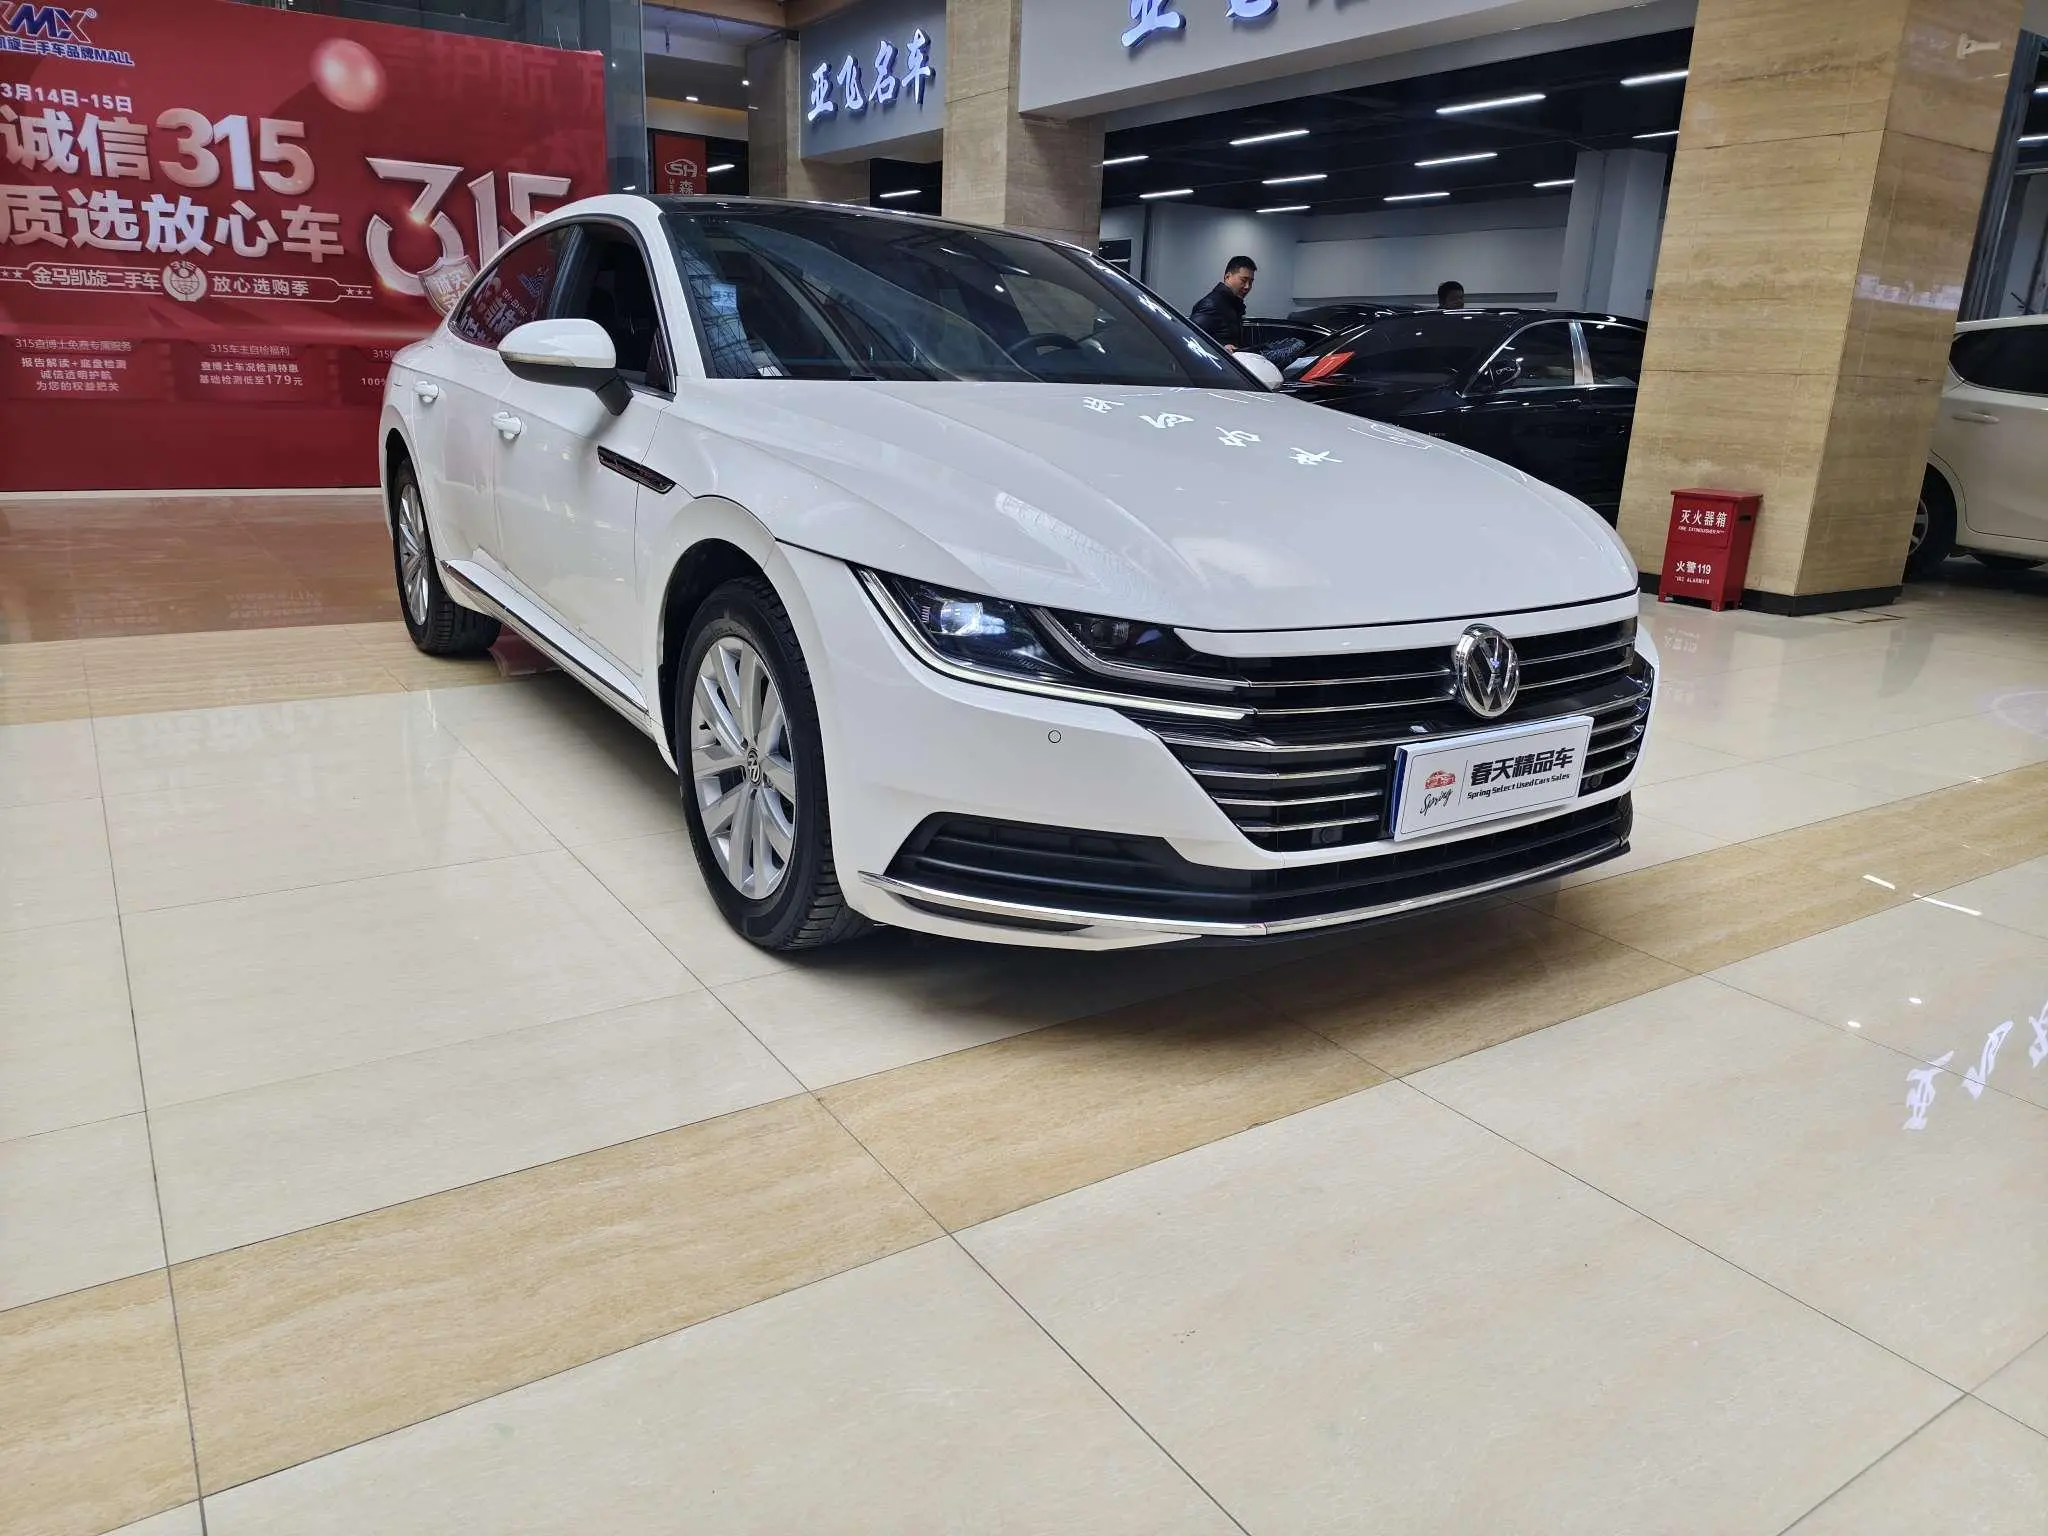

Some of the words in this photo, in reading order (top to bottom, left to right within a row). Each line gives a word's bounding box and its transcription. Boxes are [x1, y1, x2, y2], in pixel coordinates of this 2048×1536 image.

[808, 29, 931, 121] 亚飞名车
[0, 82, 132, 113] 3月14日-15日
[0, 184, 344, 263] 质选放心车
[31, 266, 160, 291] 金马凯旋二手车
[213, 276, 310, 296] 放心选购季
[1680, 509, 1728, 528] 灭火器箱
[1675, 560, 1711, 575] 火警119
[1471, 747, 1575, 787] 春天精品车
[1467, 788, 1491, 800] Spring
[1492, 782, 1516, 795] Select
[1516, 778, 1535, 790] Used
[1551, 772, 1570, 783] Sales
